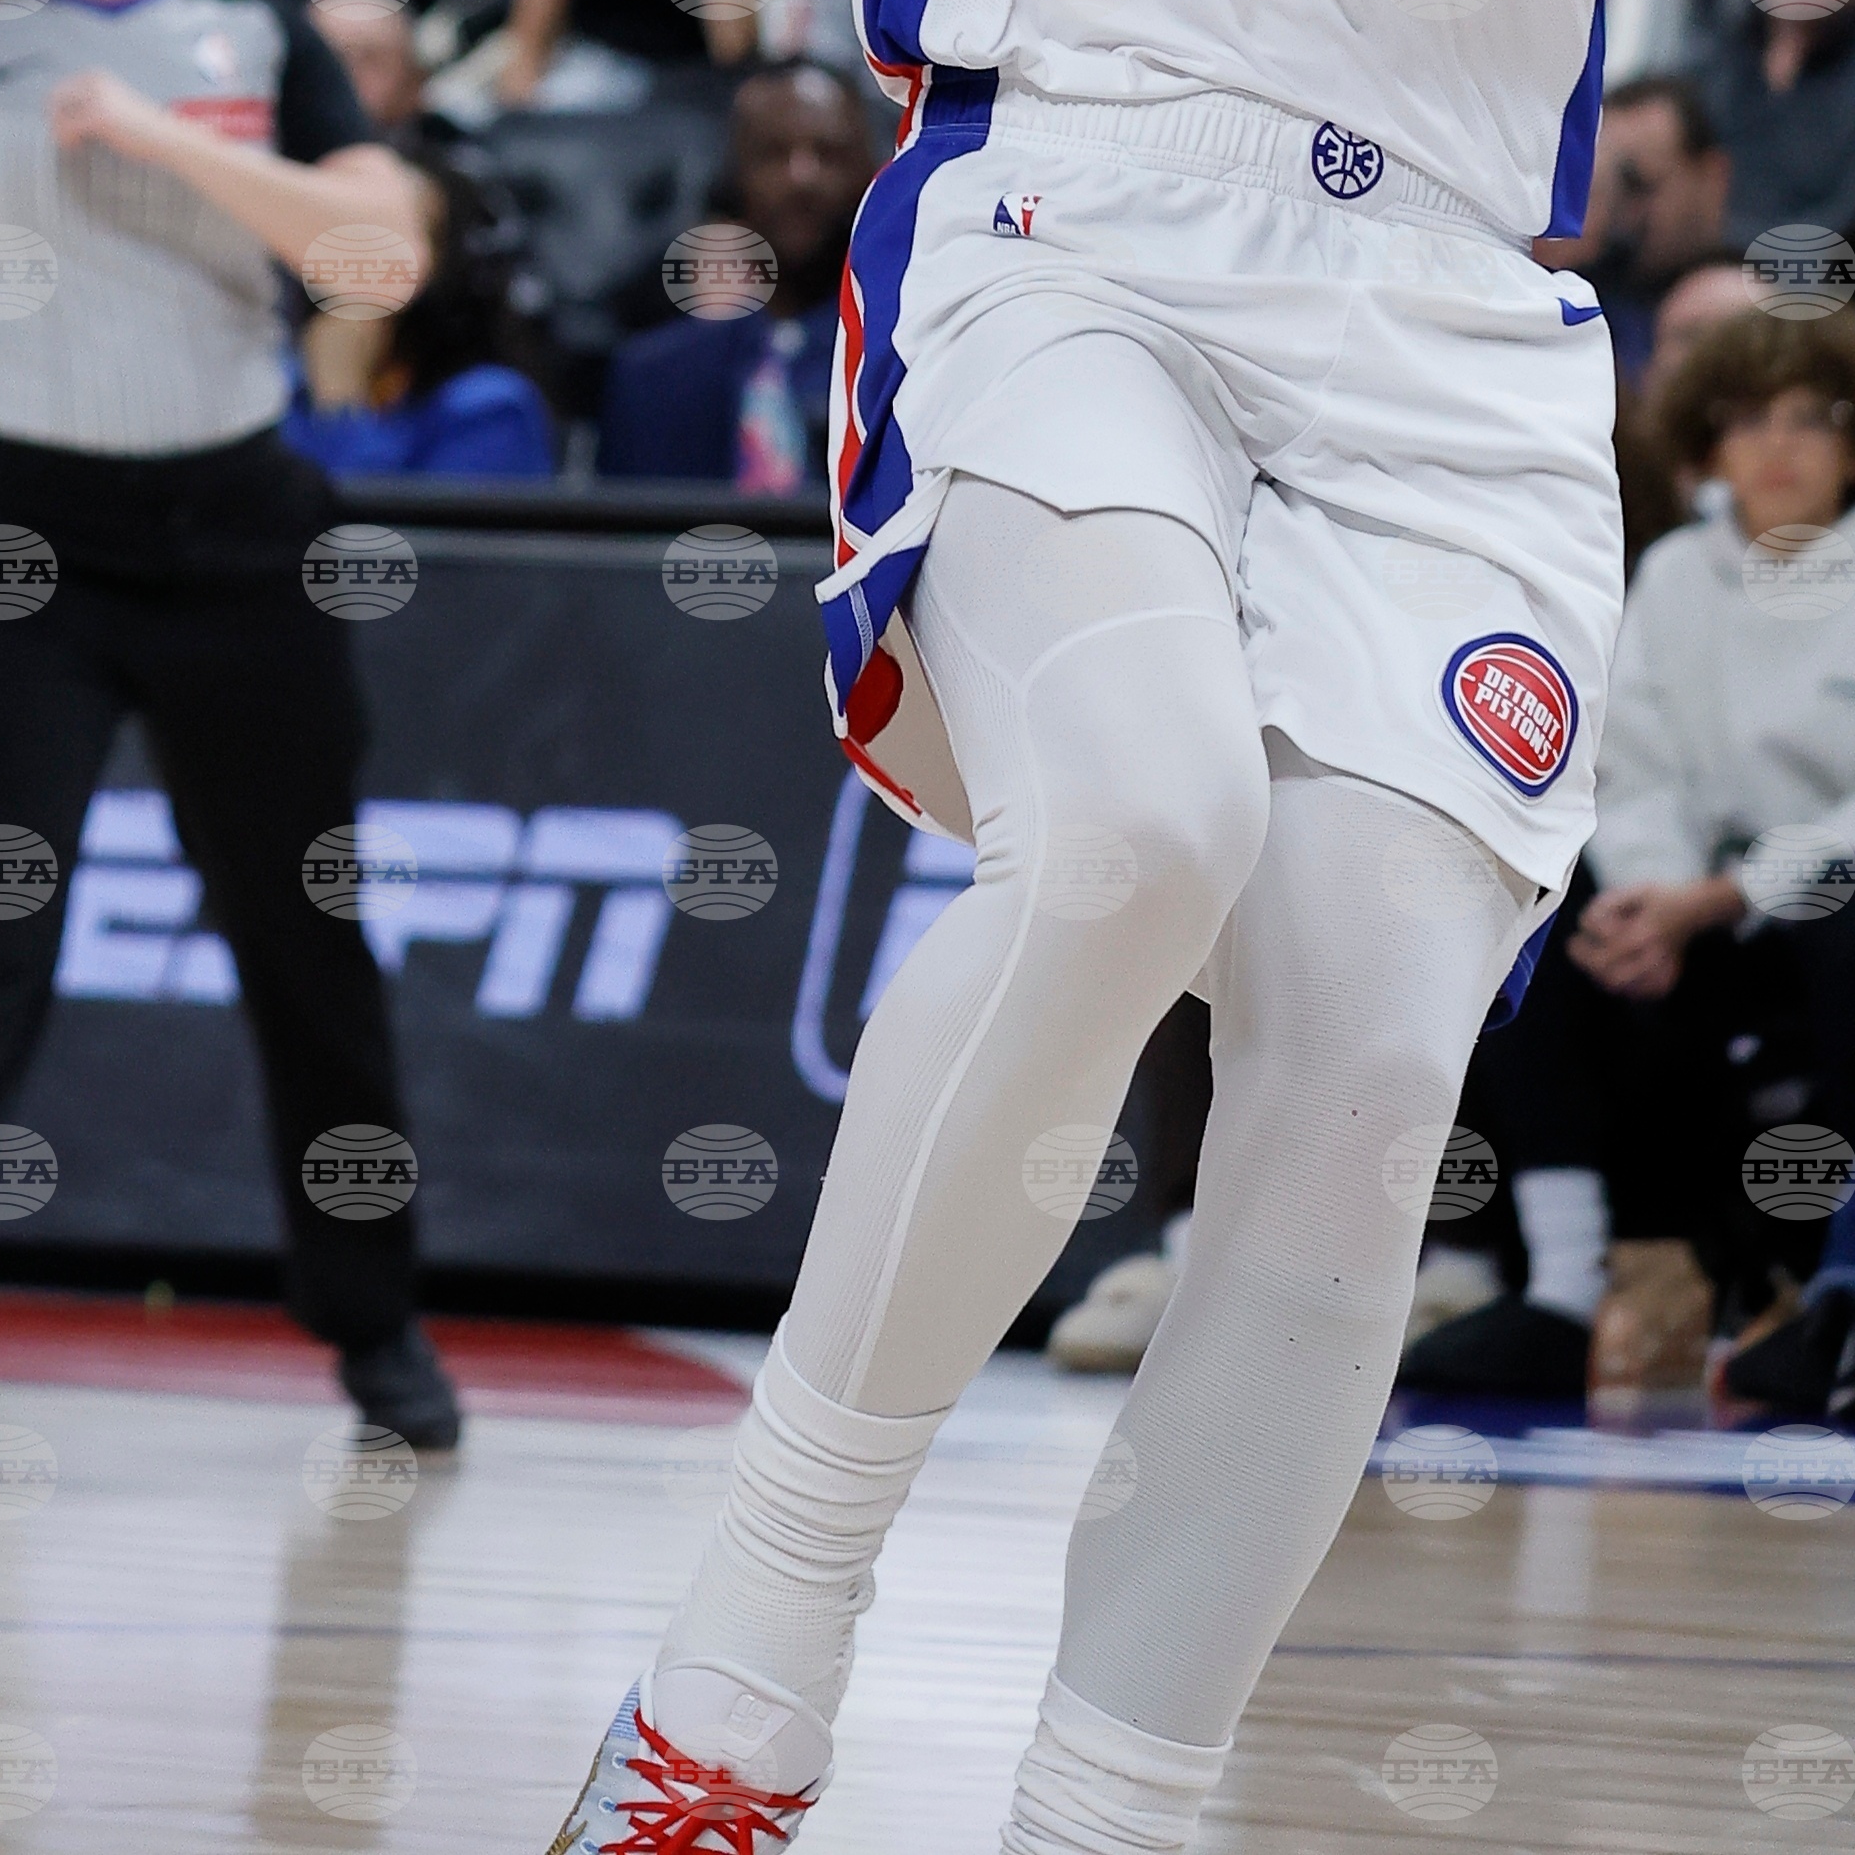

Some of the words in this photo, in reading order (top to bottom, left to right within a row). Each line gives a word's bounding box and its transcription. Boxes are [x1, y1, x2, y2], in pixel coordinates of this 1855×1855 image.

[1473, 683, 1553, 764] PISTONS
[1482, 662, 1563, 742] DETROIT
[55, 789, 690, 1021] EPN
